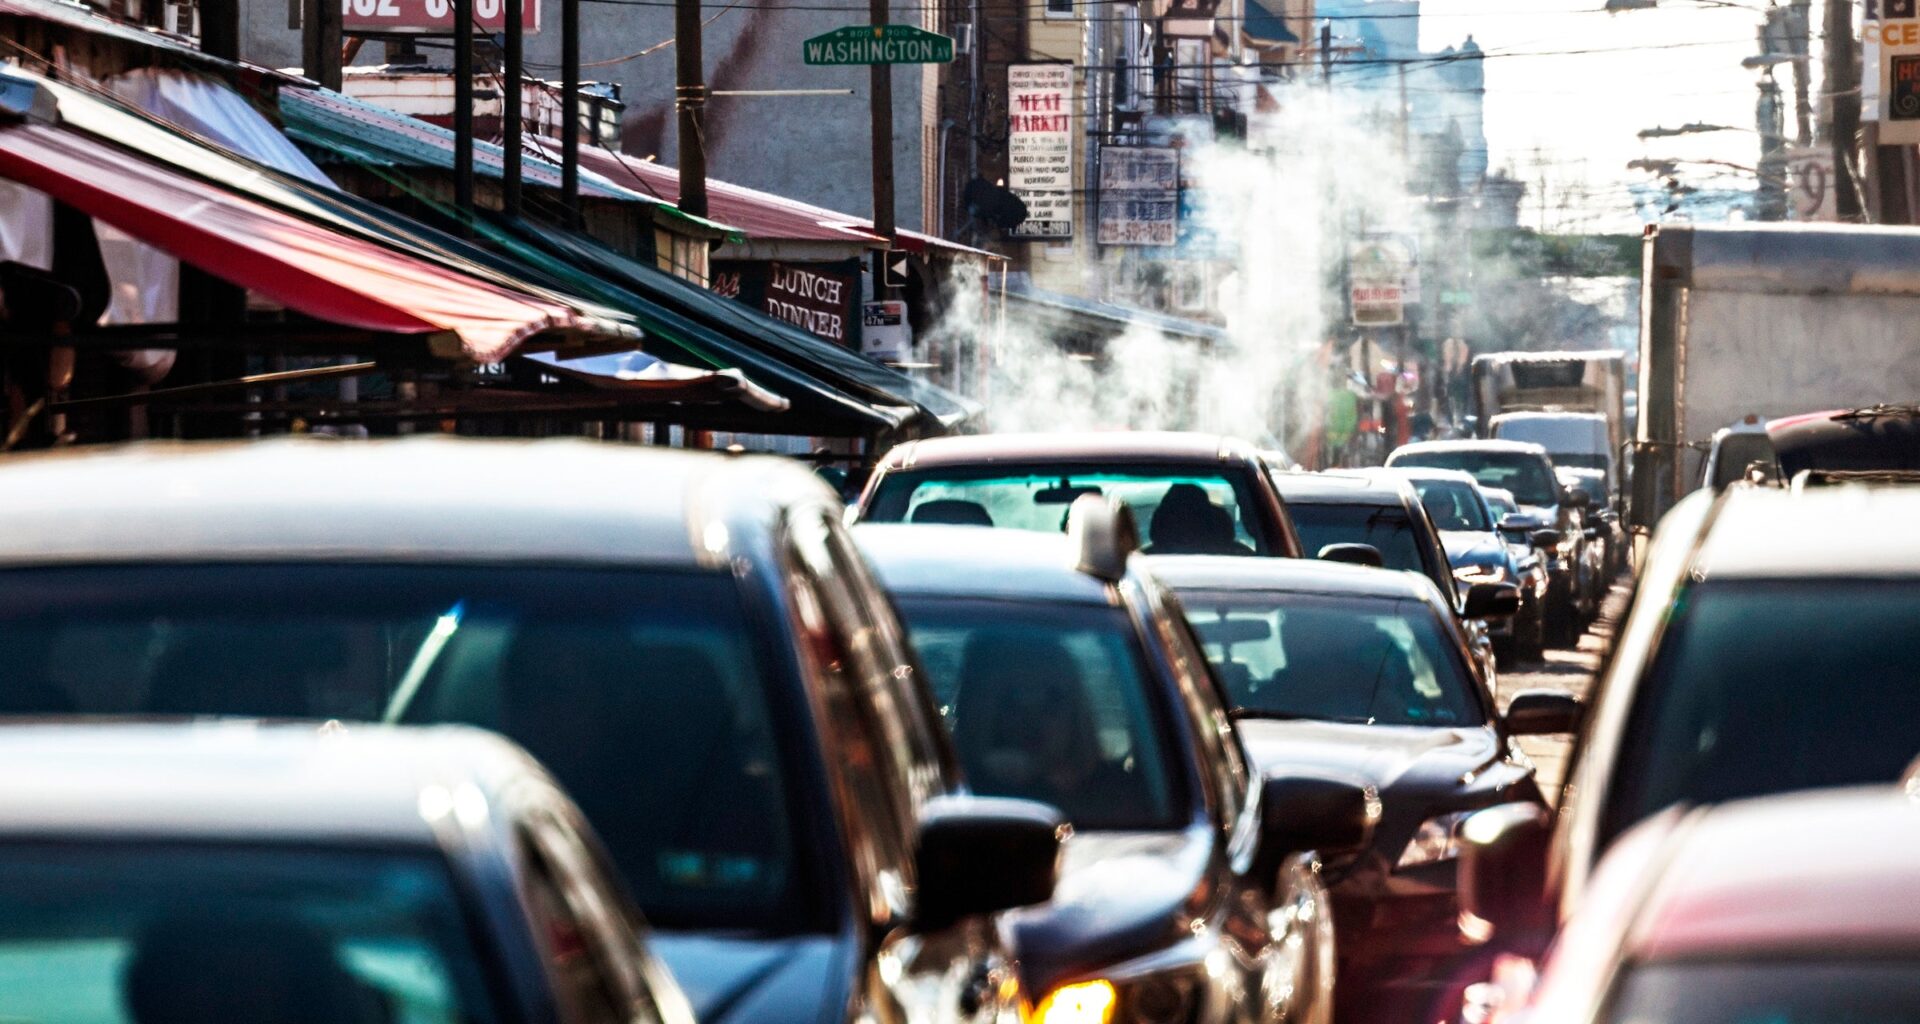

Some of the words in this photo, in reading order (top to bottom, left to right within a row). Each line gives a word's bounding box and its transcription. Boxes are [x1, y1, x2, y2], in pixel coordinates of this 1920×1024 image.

[874, 28, 883, 38] W
[808, 40, 932, 62] WASHINGTON
[936, 47, 950, 59] AV
[1018, 93, 1061, 111] MEAT
[1010, 114, 1069, 132] MARKET
[771, 262, 843, 304] LUNCH
[767, 297, 843, 340] DINNER
